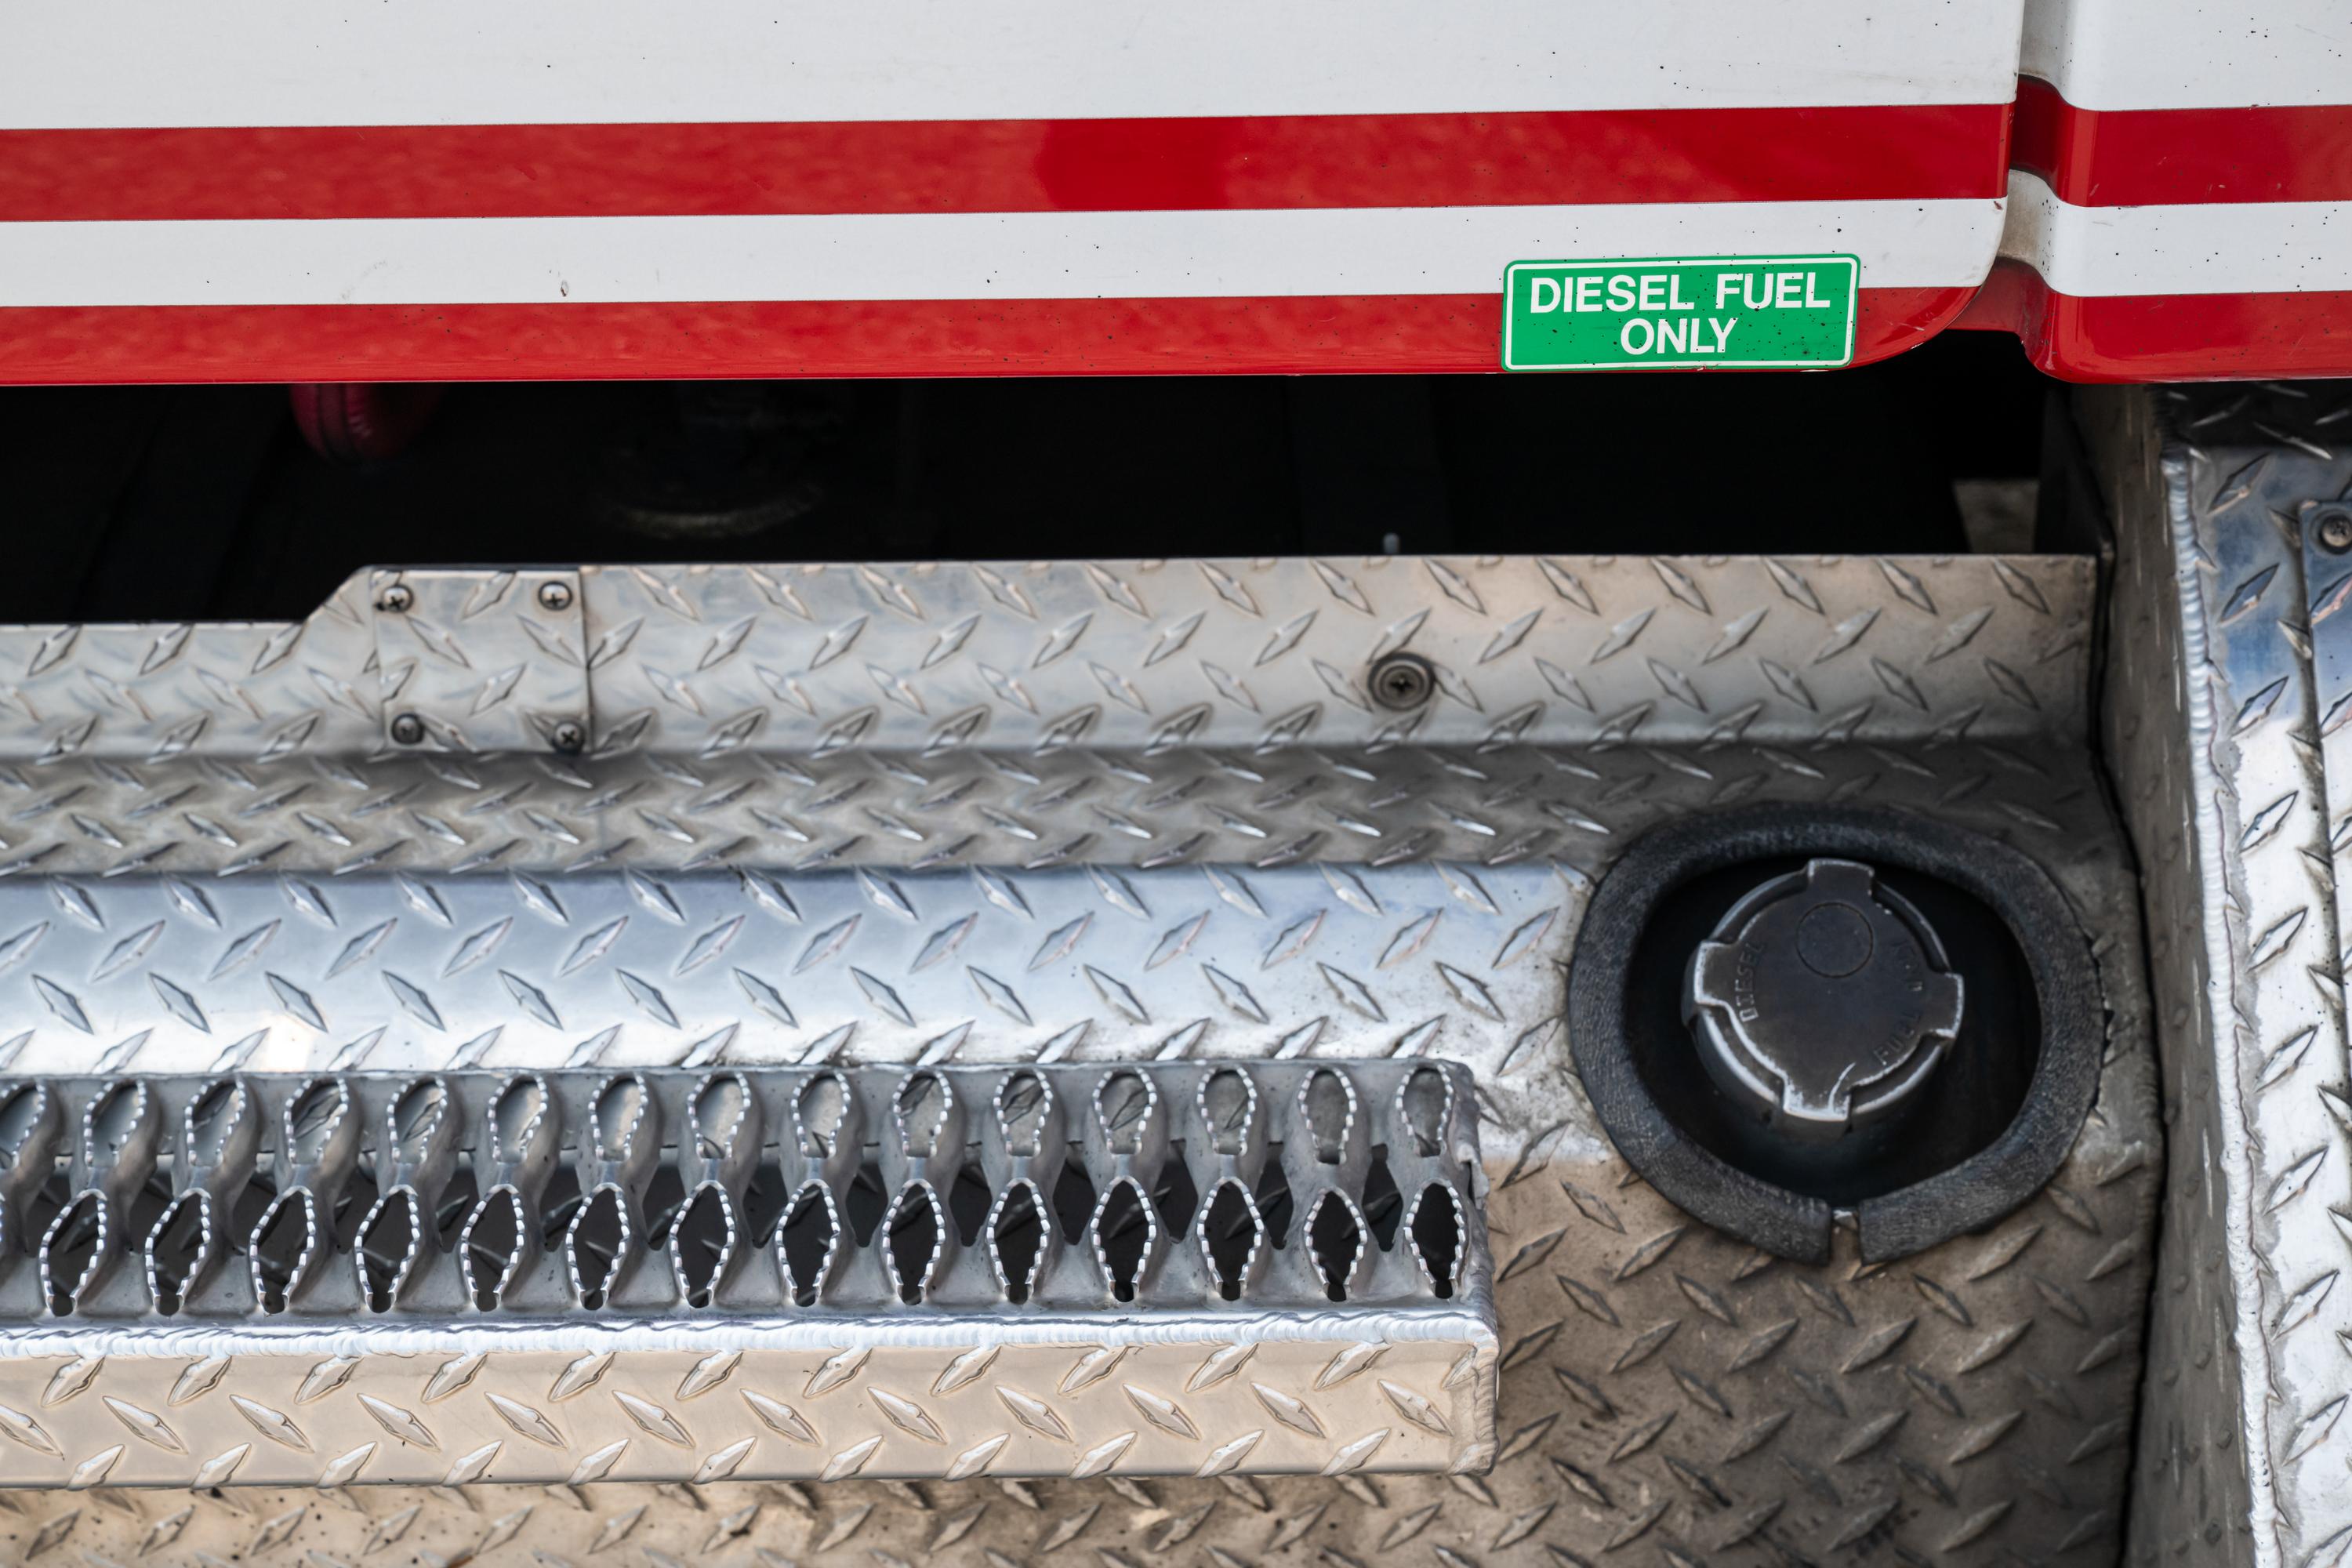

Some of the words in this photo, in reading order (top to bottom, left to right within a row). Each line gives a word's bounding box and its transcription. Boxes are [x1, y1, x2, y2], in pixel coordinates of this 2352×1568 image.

[1530, 274, 1694, 313] DIESEL
[1715, 272, 1831, 310] FUEL
[1620, 318, 1738, 355] ONLY
[1734, 942, 1764, 1022] DIESEL
